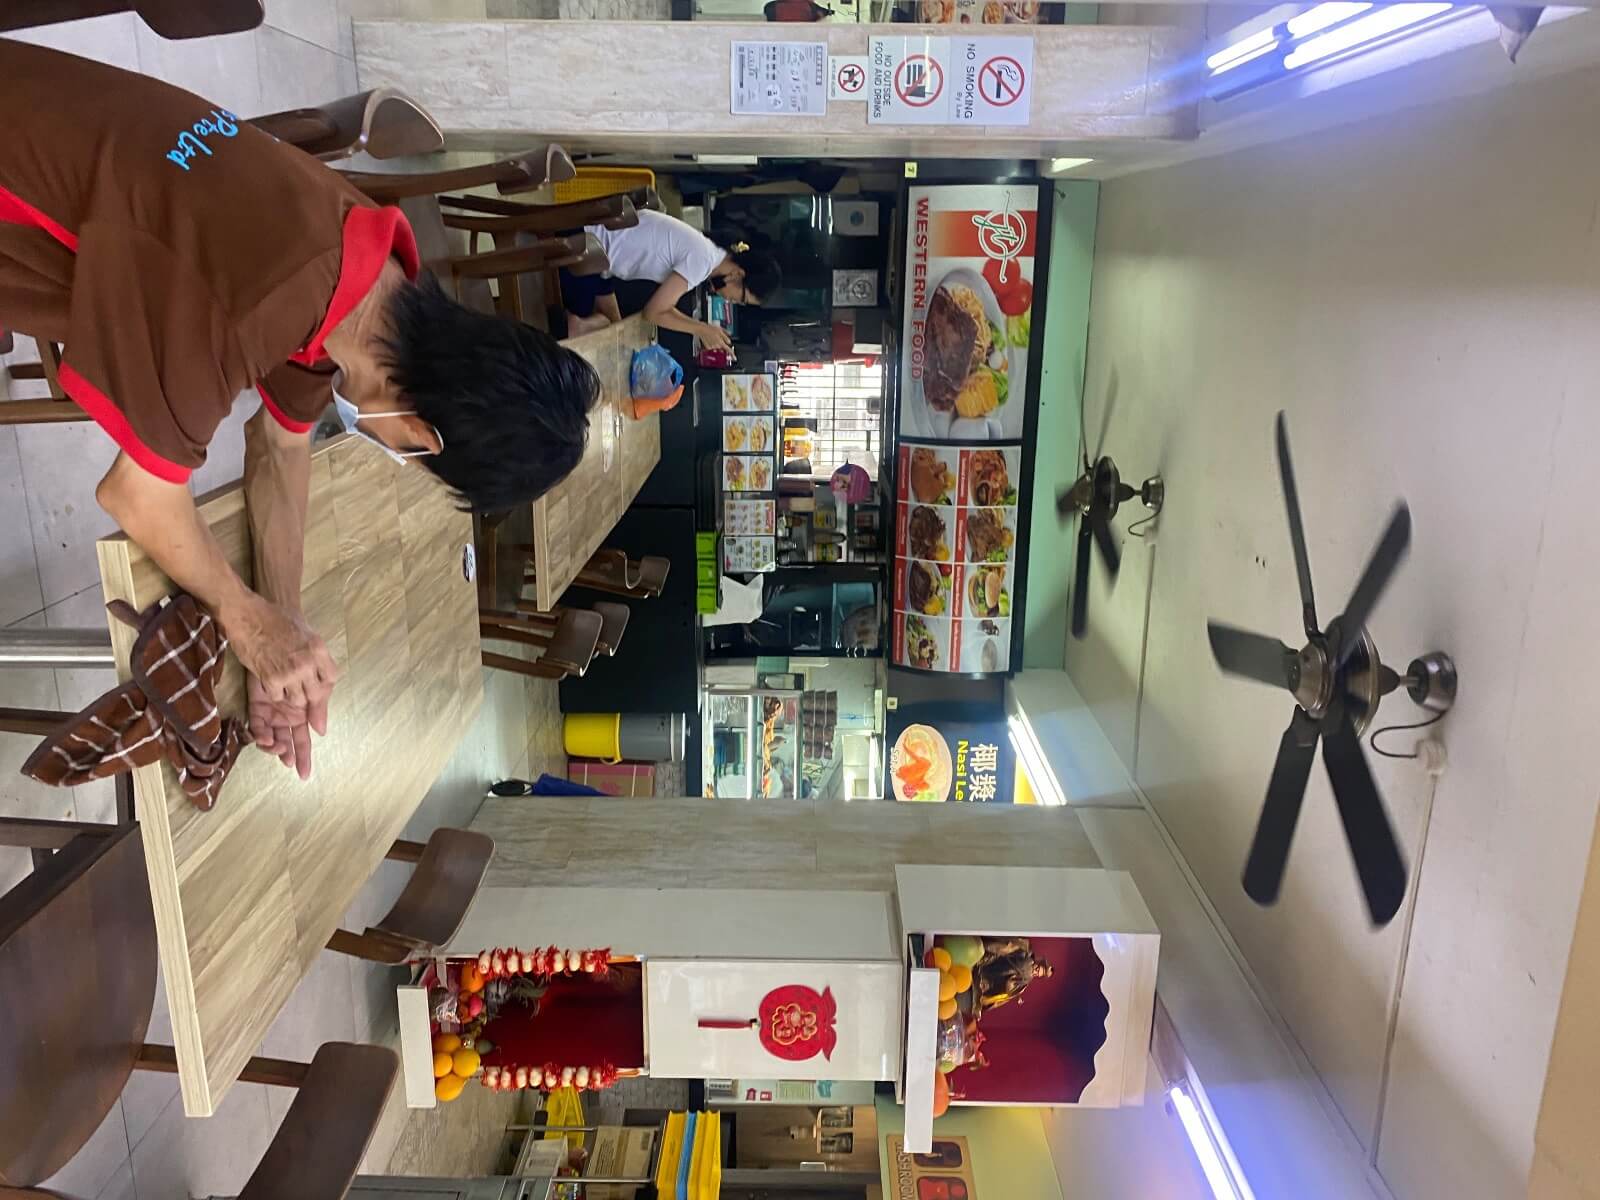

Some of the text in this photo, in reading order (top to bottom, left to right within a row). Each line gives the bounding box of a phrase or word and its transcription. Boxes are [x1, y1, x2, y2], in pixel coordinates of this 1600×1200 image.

[873, 42, 883, 118] FOOD AND DRINKS
[883, 54, 892, 106] NO OUTSIDE
[956, 92, 962, 101] By
[964, 44, 976, 119] NO SMOKING
[166, 111, 238, 170] Pte Ltd
[911, 198, 929, 380] WESTERN FOOD
[956, 740, 969, 777] Nasi
